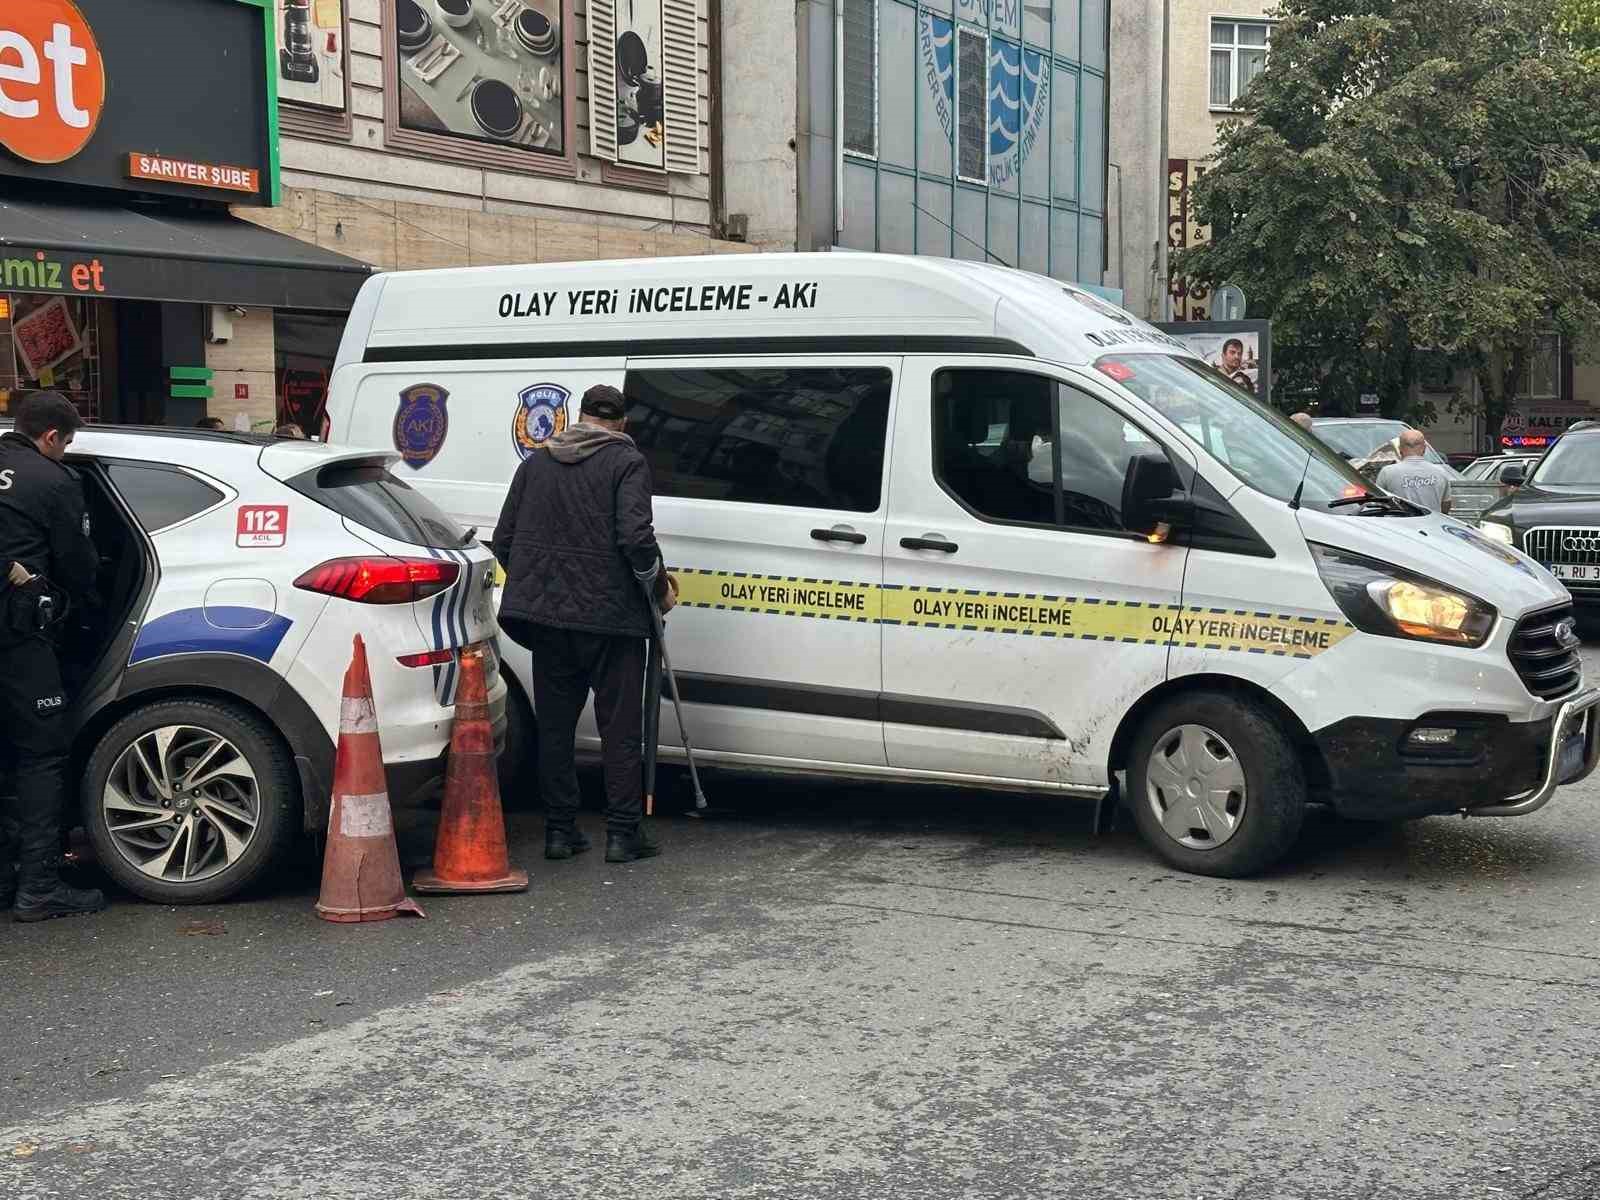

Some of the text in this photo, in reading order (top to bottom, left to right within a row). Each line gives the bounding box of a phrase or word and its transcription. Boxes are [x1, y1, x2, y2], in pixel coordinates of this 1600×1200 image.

[0, 23, 90, 129] et
[139, 157, 251, 188] SARIYER ŞUBE
[72, 259, 105, 291] et
[499, 291, 557, 318] OLAY
[245, 510, 280, 531] 112
[1552, 566, 1564, 578] 34
[1572, 567, 1586, 578] RU
[721, 582, 756, 601] OLAY
[913, 598, 952, 617] OLAY
[1152, 616, 1195, 635] OLAY
